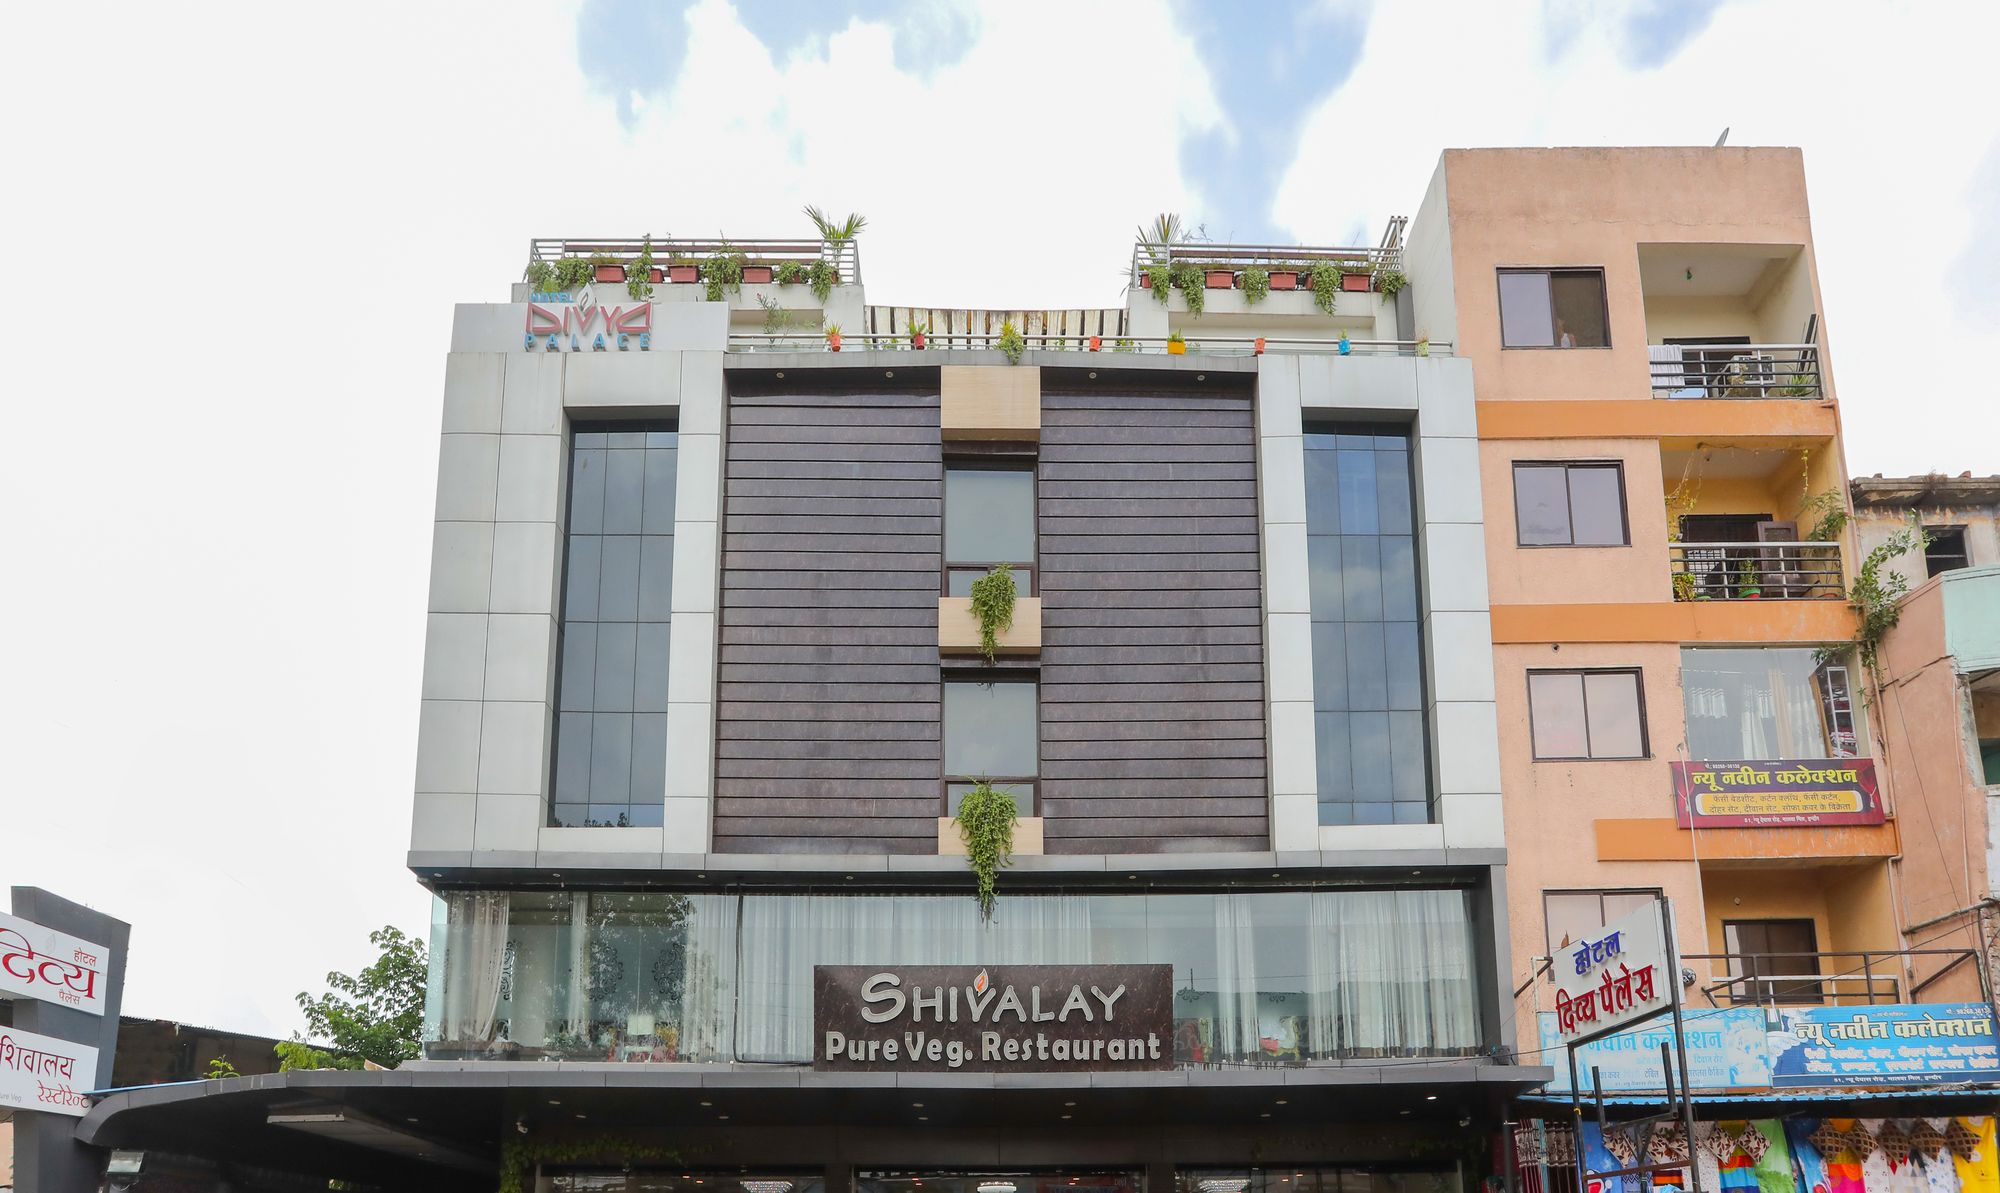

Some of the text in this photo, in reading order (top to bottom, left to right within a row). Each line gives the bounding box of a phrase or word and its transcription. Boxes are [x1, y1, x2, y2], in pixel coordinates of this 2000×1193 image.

[530, 292, 574, 303] HOTEL
[526, 302, 652, 336] DIVYA
[524, 333, 650, 352] PALACE
[1691, 764, 1858, 792] न्यू नवीन कलेक्शन
[1782, 803, 1800, 812] सोफा
[1802, 803, 1818, 811] कवर
[1820, 802, 1826, 810] के
[0, 927, 100, 1000] दिव्य
[74, 947, 97, 968] होटल
[1572, 930, 1620, 975] होटल
[58, 988, 80, 1005] पैलेस
[860, 972, 1126, 1024] SHIVALAY
[1556, 962, 1655, 1034] दिव्य पैलेस
[1795, 1012, 1993, 1048] न्यू नवीन कलेक्शन
[0, 1034, 76, 1082] शिवालय
[826, 1030, 1161, 1068] Pure Veg. Restaurant
